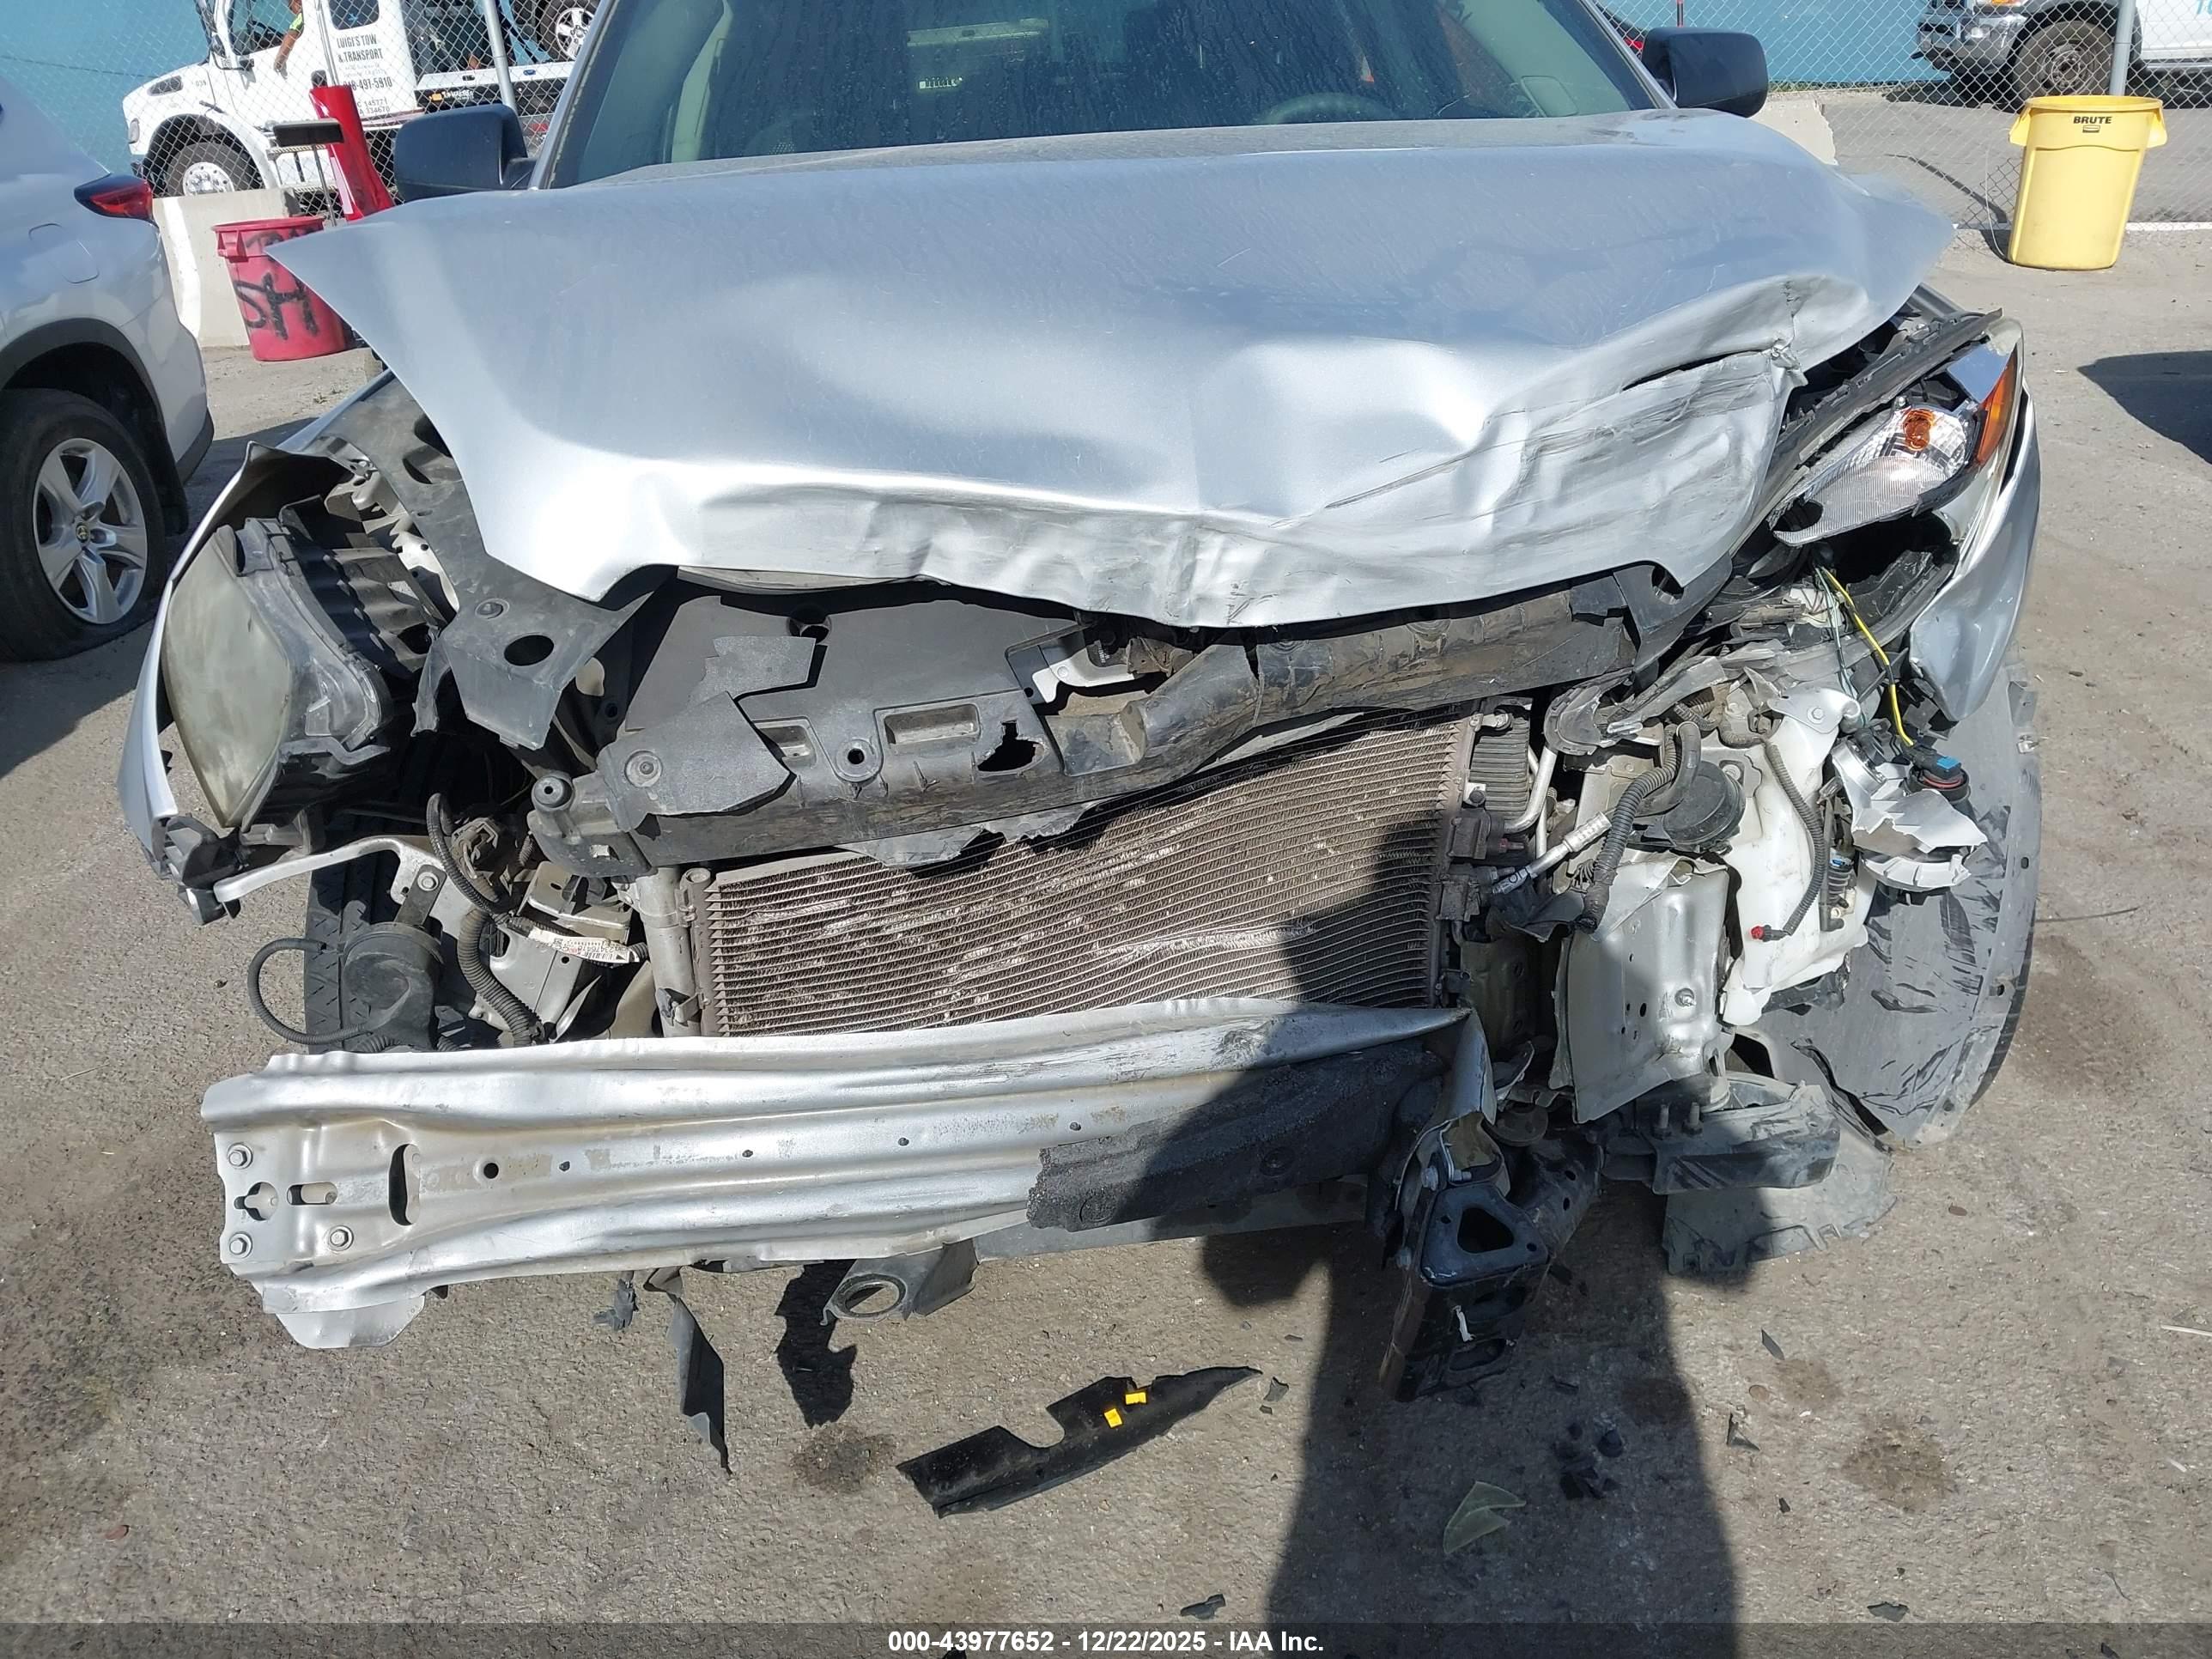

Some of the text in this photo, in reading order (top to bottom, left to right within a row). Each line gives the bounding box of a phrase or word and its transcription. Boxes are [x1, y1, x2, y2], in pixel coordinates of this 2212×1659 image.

[337, 34, 377, 48] LUIGI'S TOW
[343, 48, 384, 62] TRANSPORT
[2073, 116, 2112, 125] BRUTE
